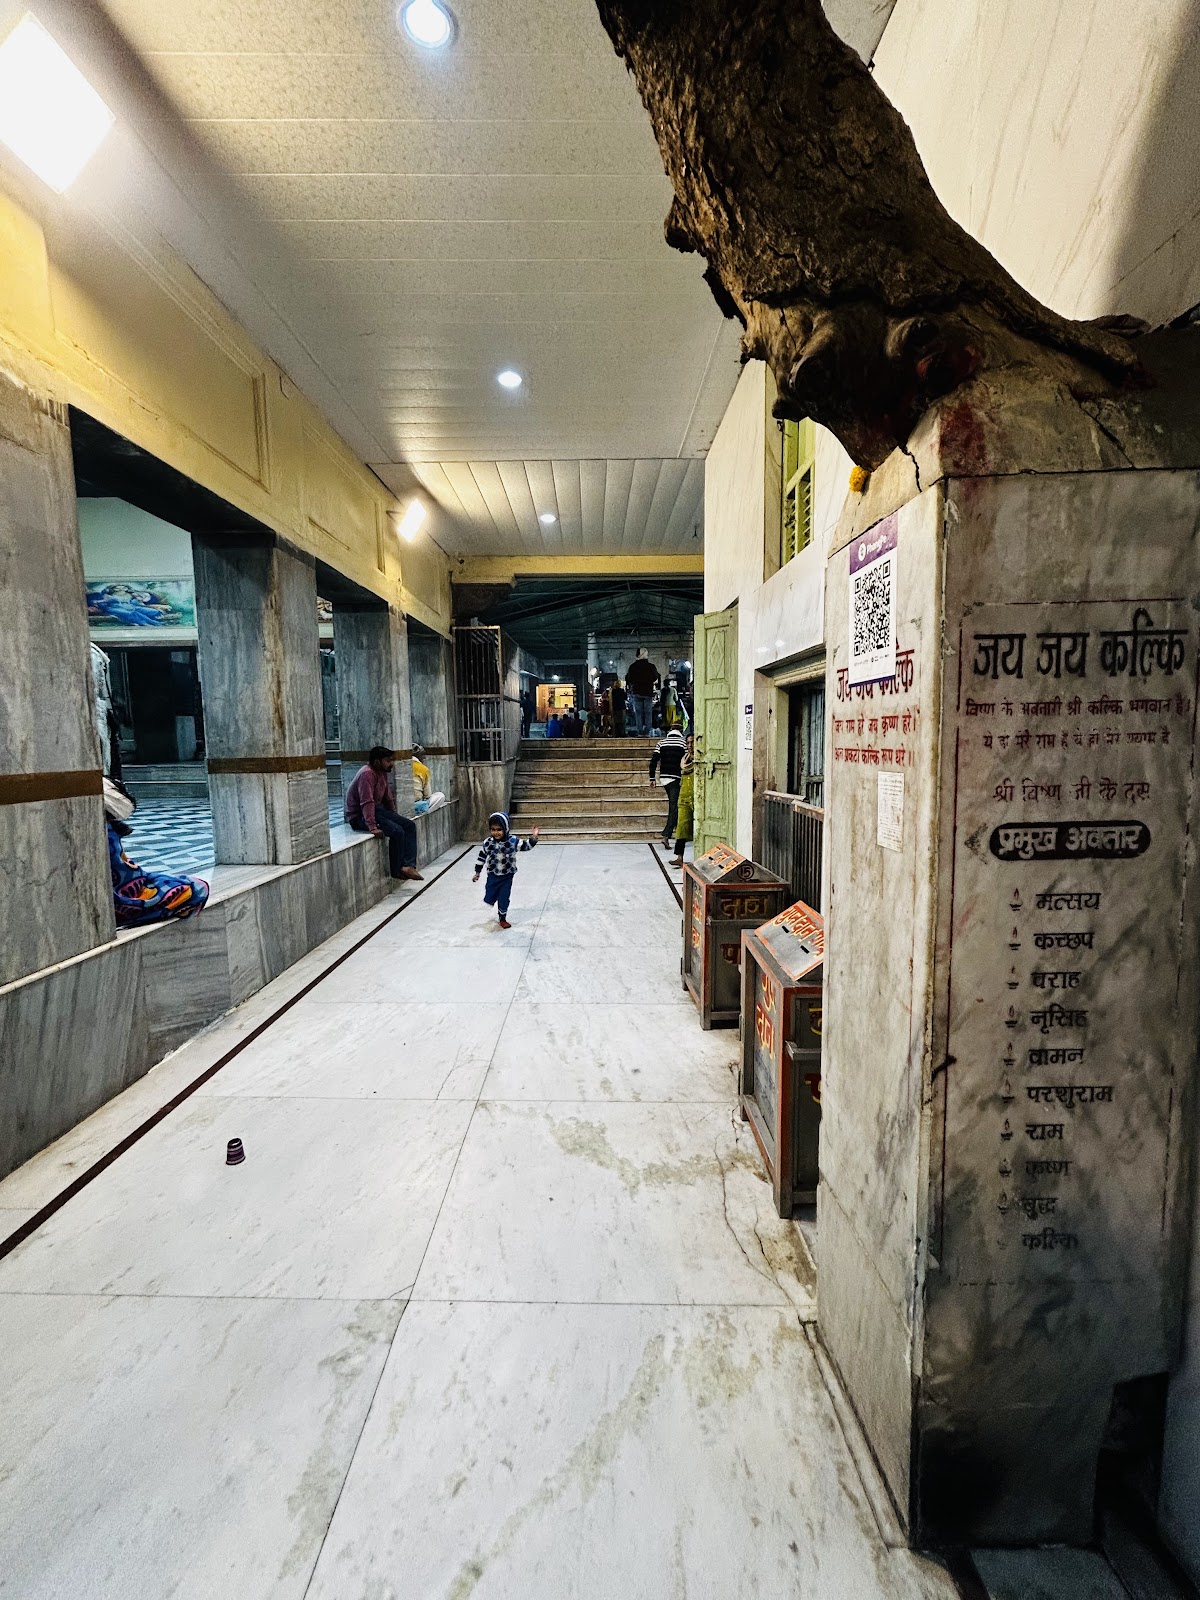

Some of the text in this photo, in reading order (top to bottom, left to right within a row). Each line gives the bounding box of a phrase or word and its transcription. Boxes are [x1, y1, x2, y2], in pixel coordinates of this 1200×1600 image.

[974, 607, 1188, 679] जय जय कल्कि
[1067, 695, 1081, 716] श्री
[1087, 694, 1123, 716] कल्कि
[1129, 698, 1171, 715] भगवान
[881, 715, 899, 737] कृष्ण
[1036, 732, 1056, 749] राम
[861, 744, 880, 765] कल्कि
[993, 777, 1015, 802] श्री
[1100, 777, 1118, 801] के
[1123, 781, 1151, 803] दस
[998, 825, 1142, 859] प्रमुख अवतार
[1034, 931, 1094, 950] कच्छप
[1031, 971, 1082, 989] वराह
[1028, 1048, 1085, 1066] वामन
[1026, 1084, 1113, 1108] परशुराम
[1025, 1122, 1065, 1140] राम
[1021, 1227, 1079, 1250] कल्कि
